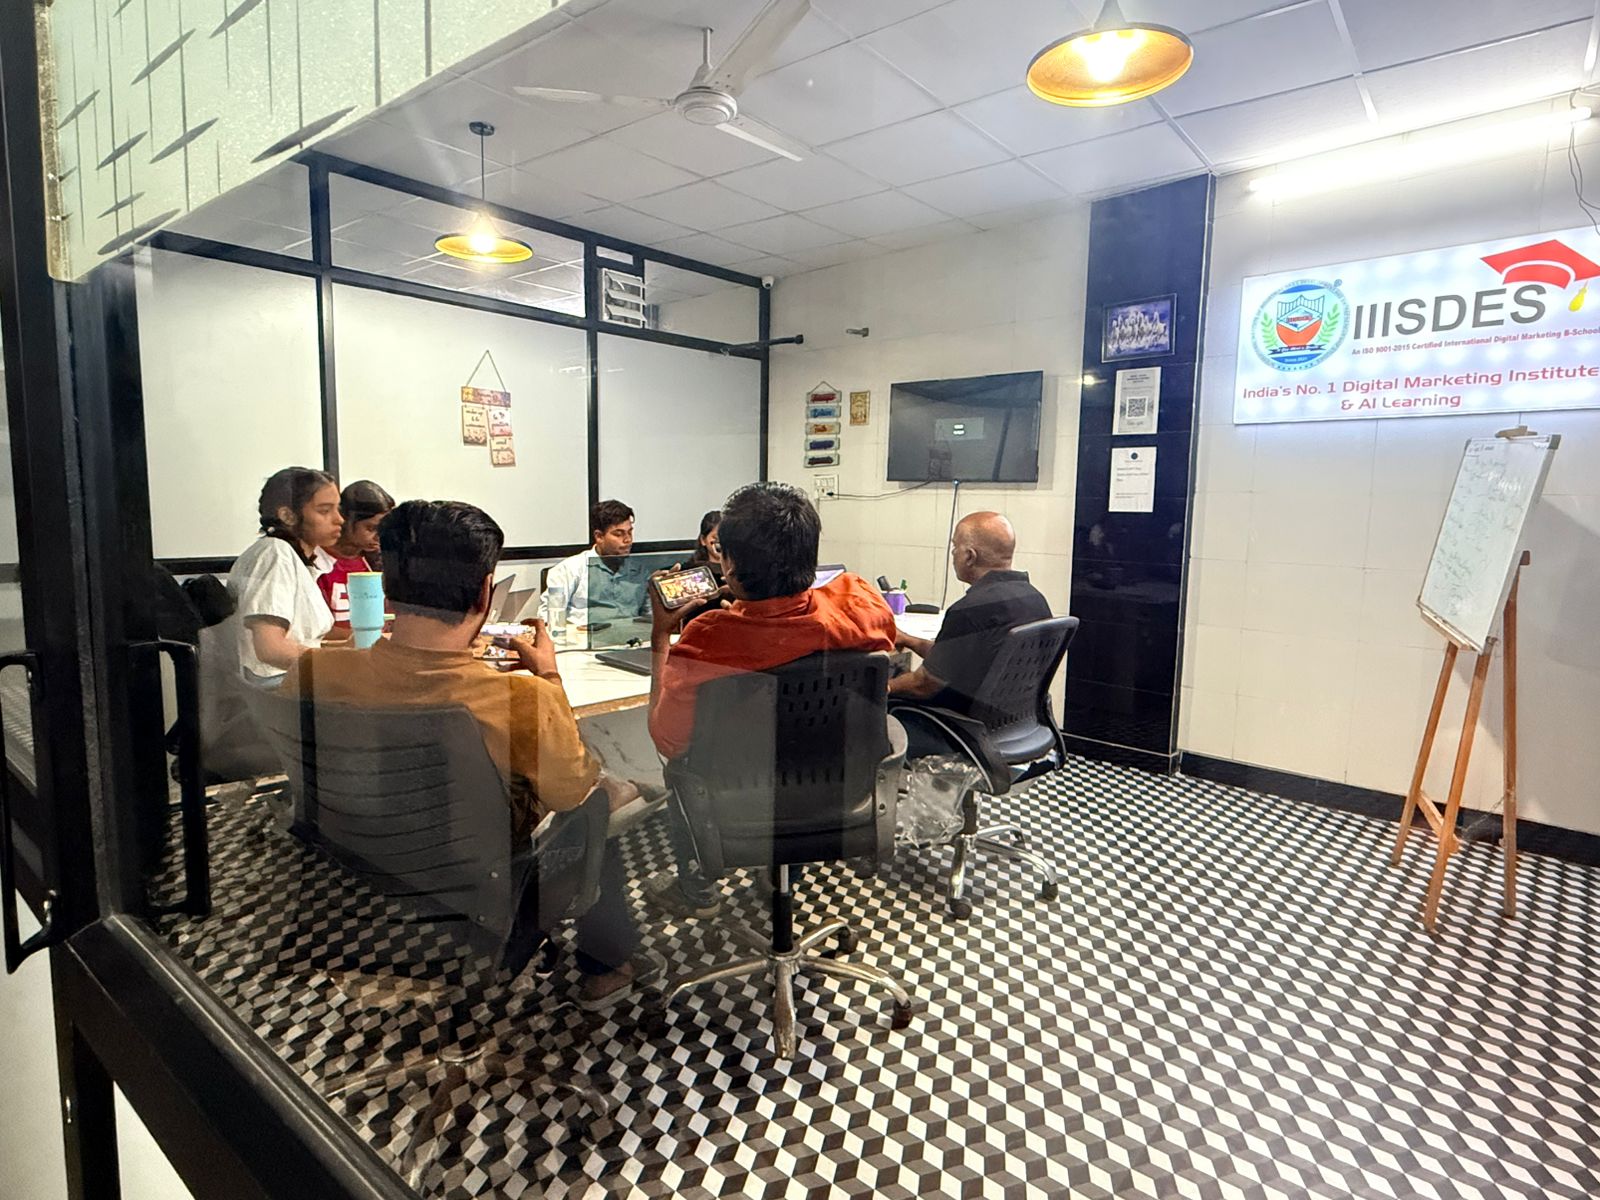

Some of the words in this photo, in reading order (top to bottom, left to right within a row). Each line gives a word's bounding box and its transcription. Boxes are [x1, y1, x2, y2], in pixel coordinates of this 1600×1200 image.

[1353, 284, 1547, 340] IIISDES
[1362, 346, 1374, 354] ISO
[1376, 343, 1410, 354] 9001-2015
[1412, 340, 1443, 350] Certified
[1444, 336, 1492, 346] International
[1494, 333, 1519, 343] Digital
[1521, 330, 1562, 340] Marketing
[1243, 385, 1292, 399] India's
[1296, 383, 1321, 395] No.
[1327, 382, 1337, 393] 1
[1342, 378, 1399, 394] Digital
[1404, 372, 1502, 388] Marketing
[1508, 364, 1600, 382] Institute
[1341, 399, 1354, 410] &
[1358, 398, 1377, 409] AI
[1382, 394, 1461, 408] Learning
